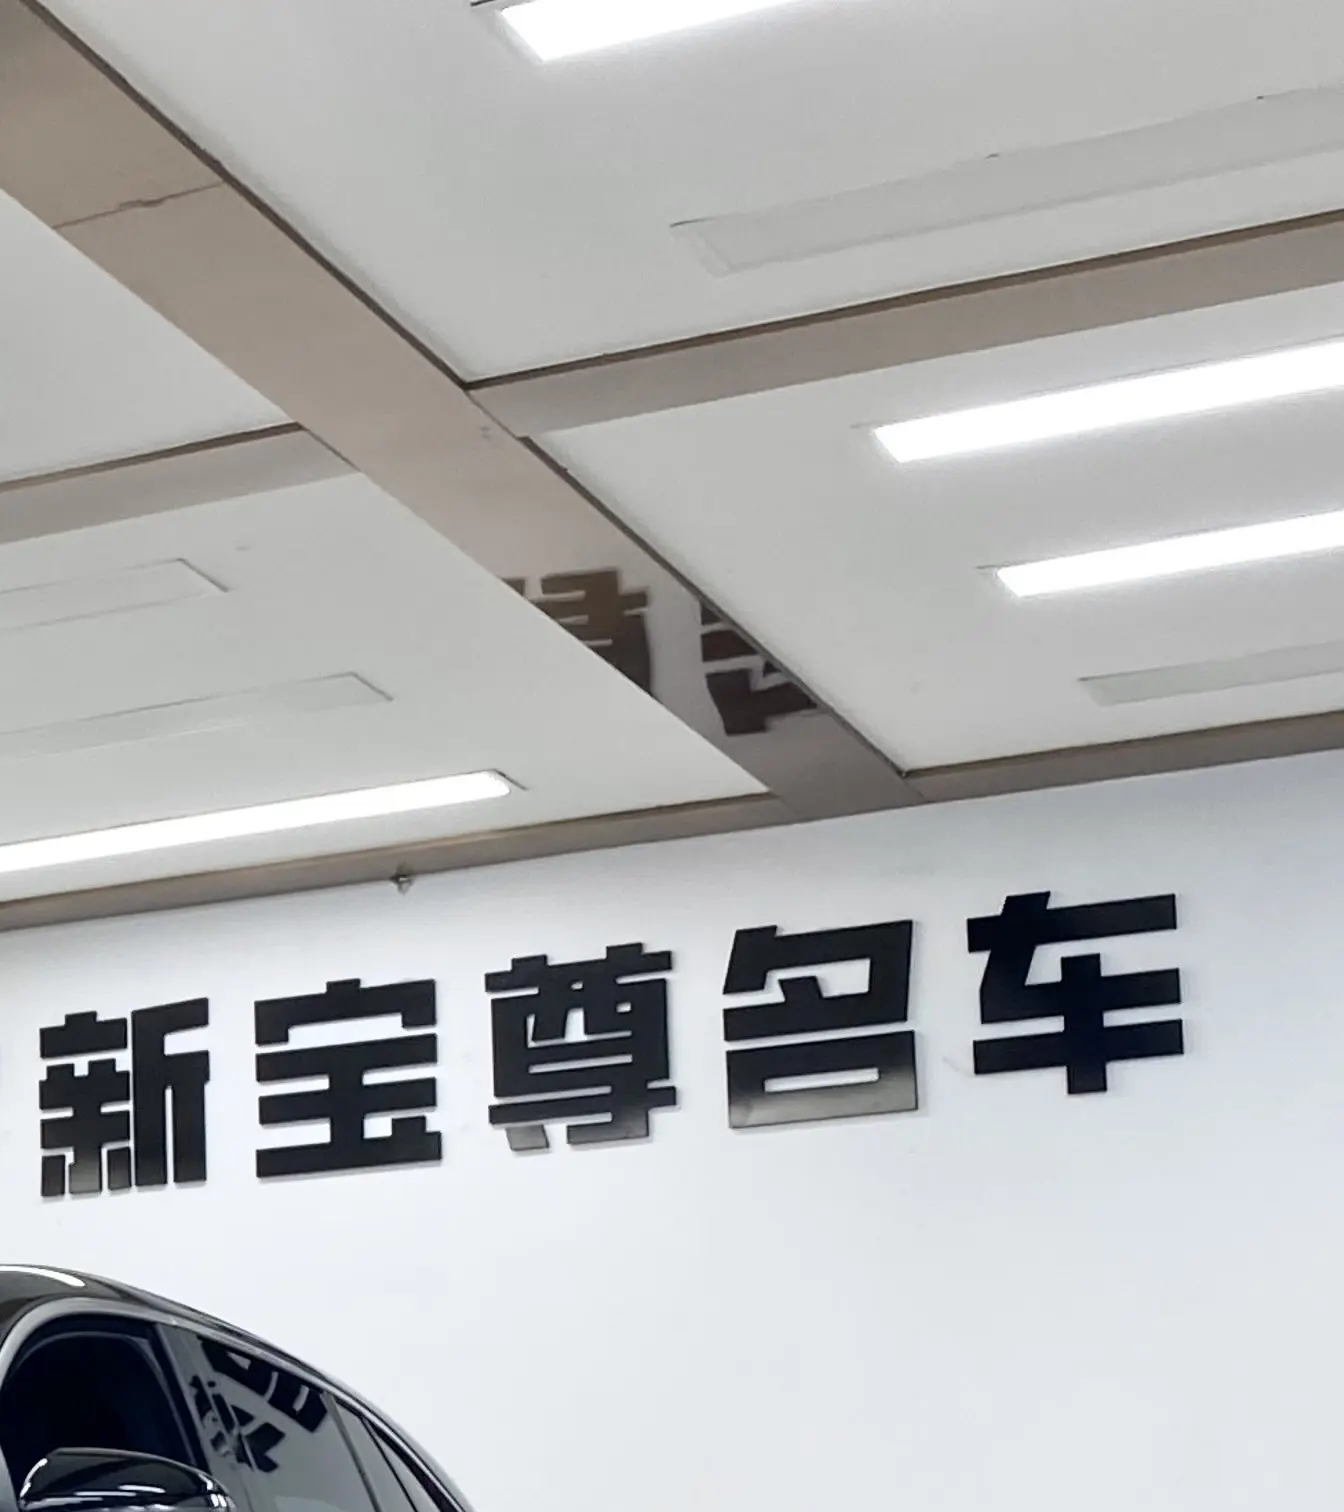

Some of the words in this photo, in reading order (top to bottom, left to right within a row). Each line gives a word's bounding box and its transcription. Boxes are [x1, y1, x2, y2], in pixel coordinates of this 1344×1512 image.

[39, 891, 1184, 1197] 新宝尊名车
